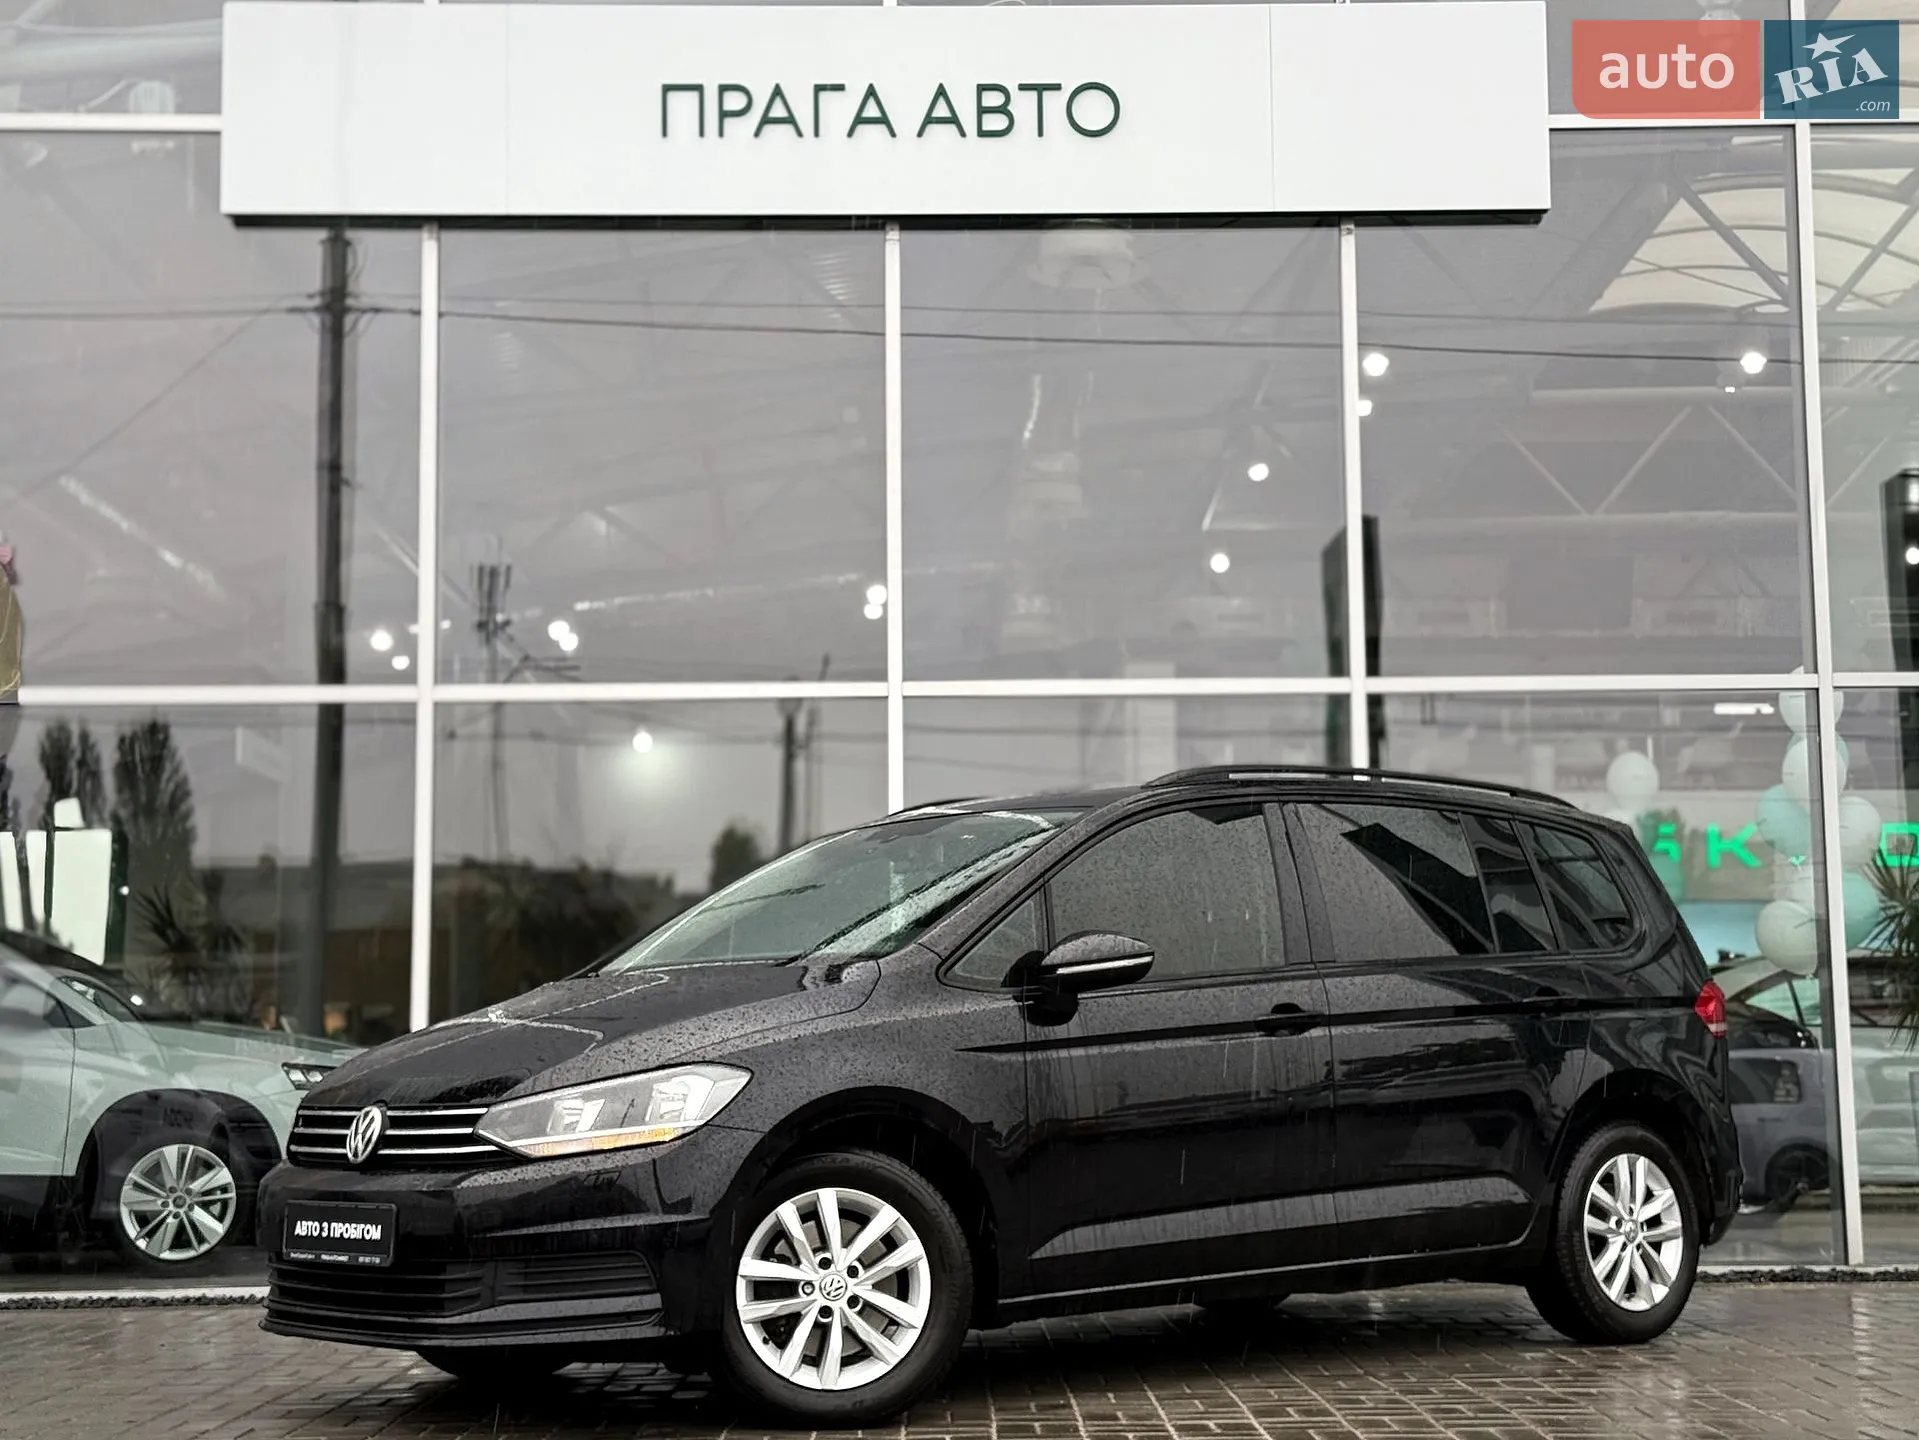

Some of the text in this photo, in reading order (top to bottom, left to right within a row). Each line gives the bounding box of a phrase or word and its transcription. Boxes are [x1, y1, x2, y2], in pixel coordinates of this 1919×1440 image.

[661, 81, 1121, 138] ПРАГА АВТО
[294, 1220, 382, 1241] АВТО З ПРОБІГОМ
